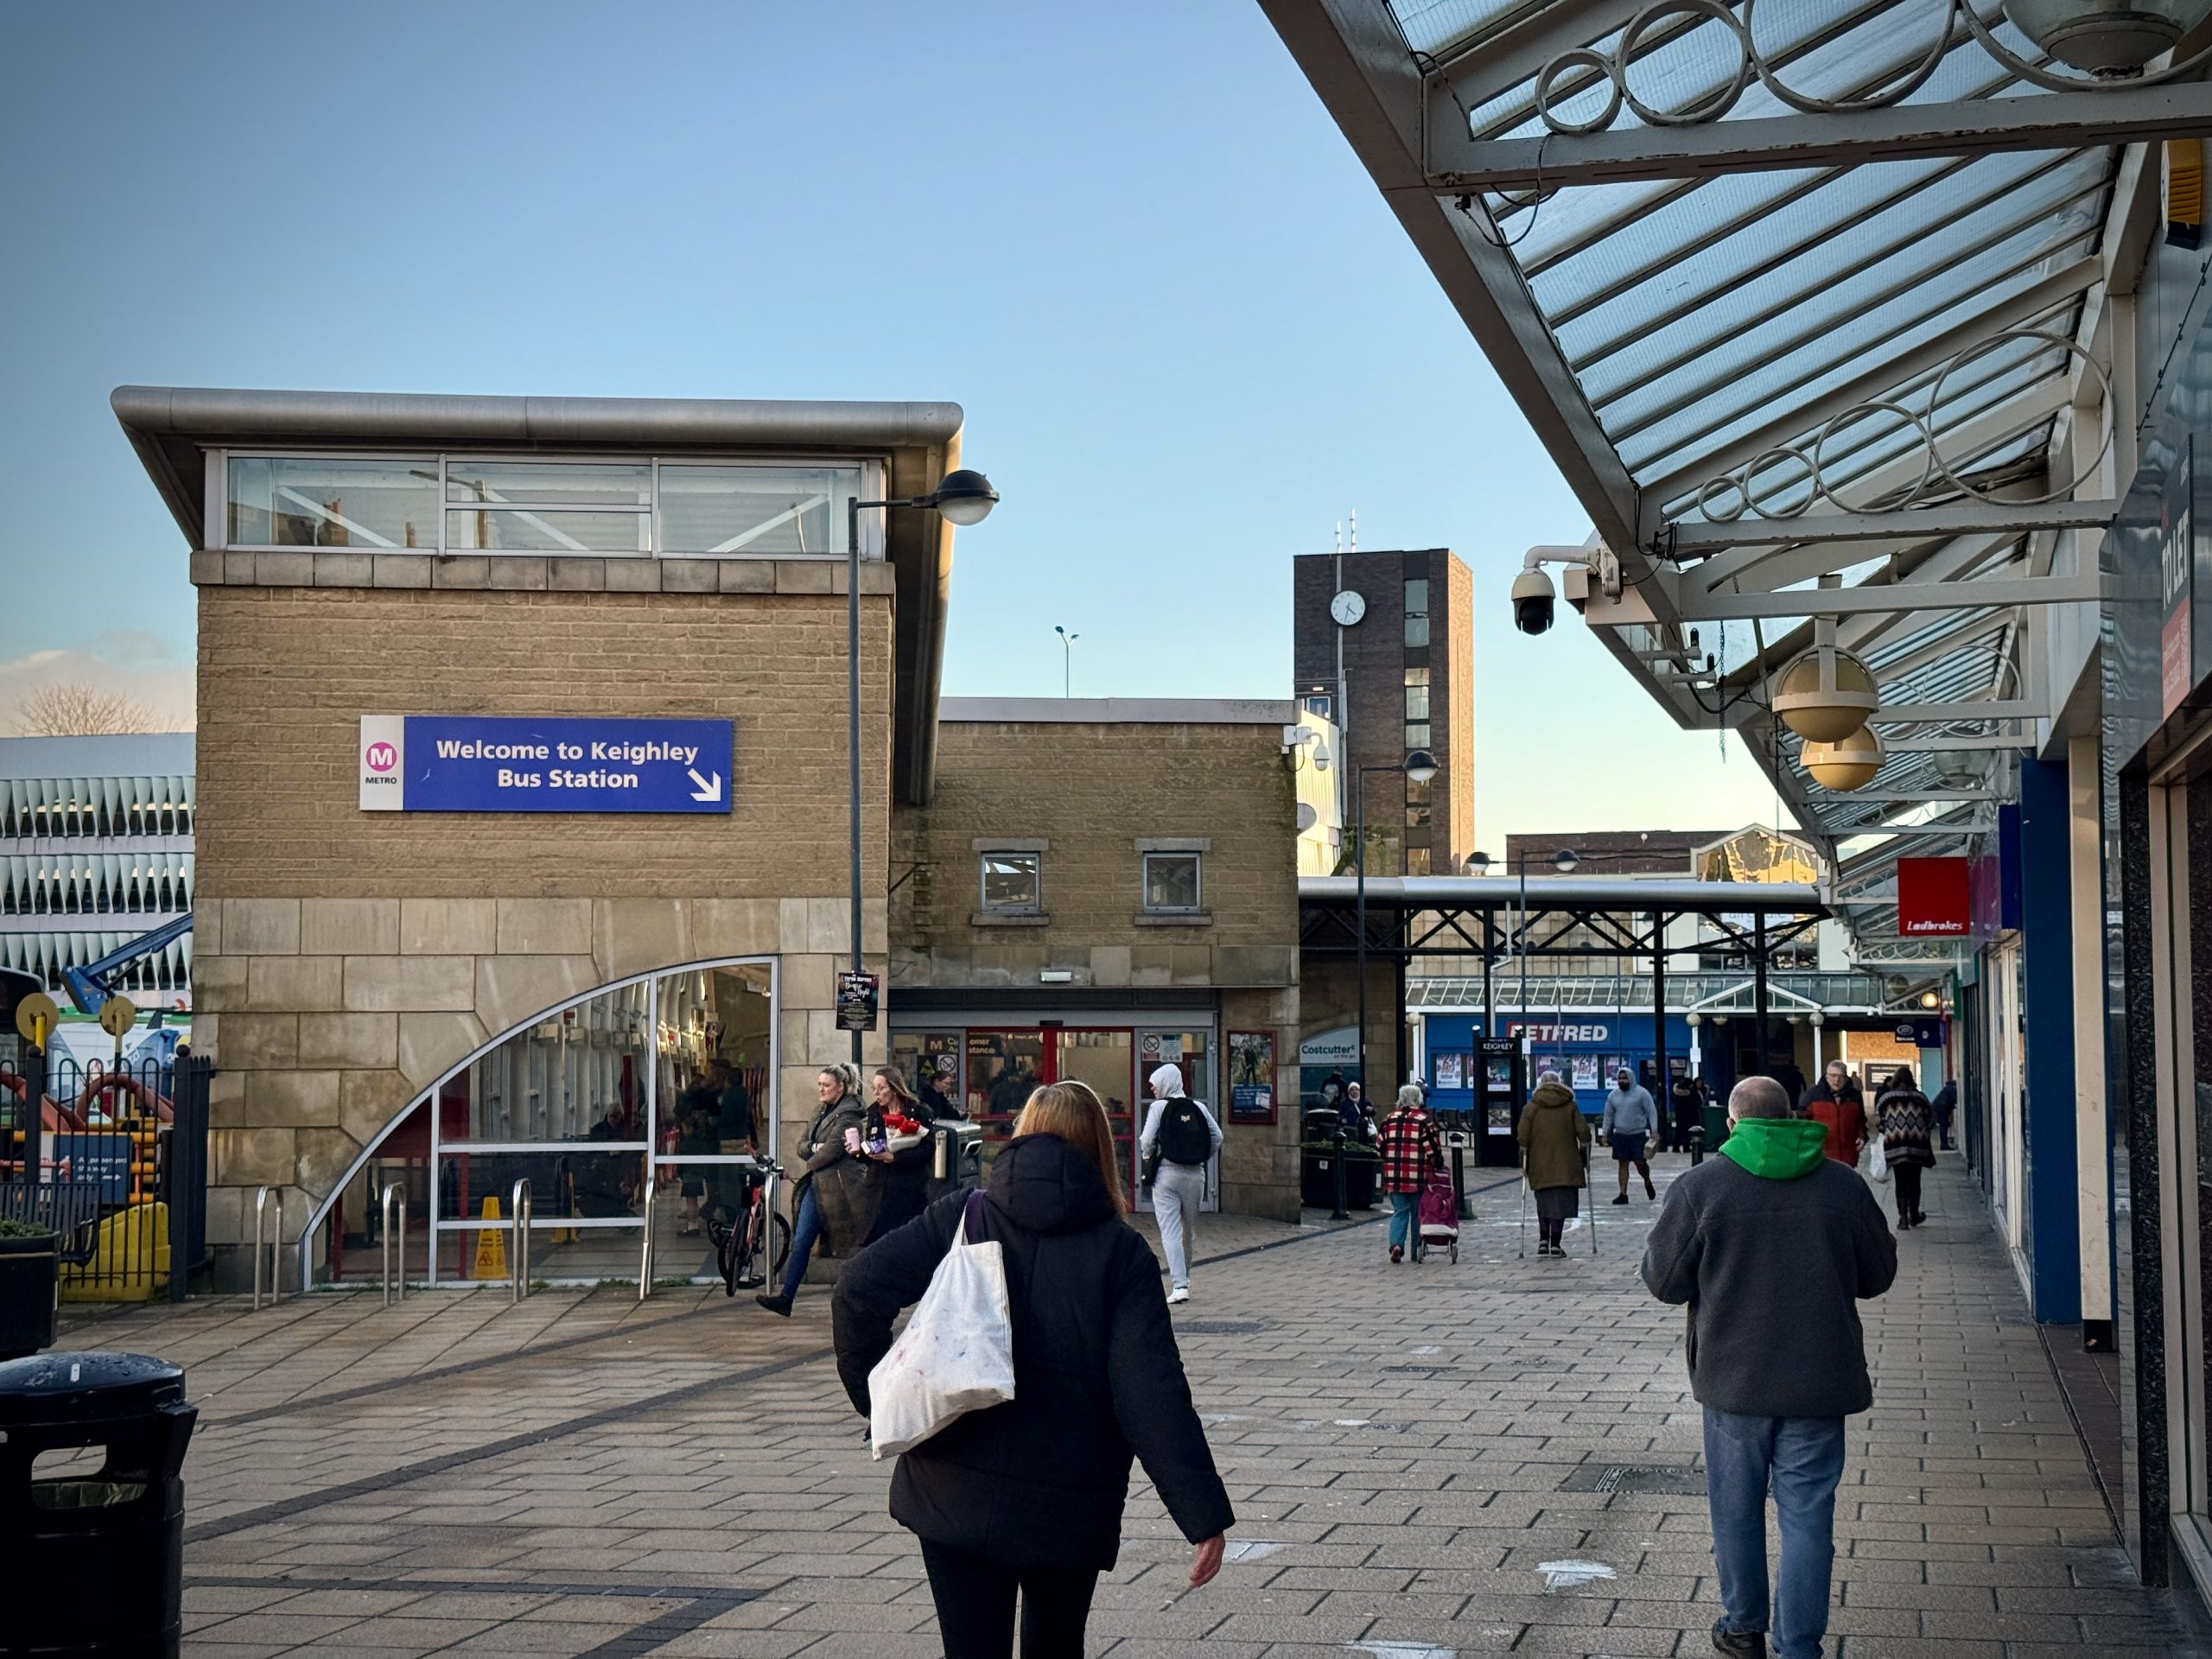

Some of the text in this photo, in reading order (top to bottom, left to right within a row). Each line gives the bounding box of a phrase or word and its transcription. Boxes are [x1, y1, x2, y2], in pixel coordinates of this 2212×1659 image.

[2162, 507, 2189, 611] TO LET
[370, 747, 393, 766] M
[436, 740, 699, 766] Welcome to Keighley
[498, 769, 639, 789] Bus Station
[1906, 919, 1963, 931] Ladbrokes
[930, 1040, 943, 1051] M
[1301, 1045, 1352, 1054] Costcutter
[1483, 1042, 1514, 1051] KEIGHLEY
